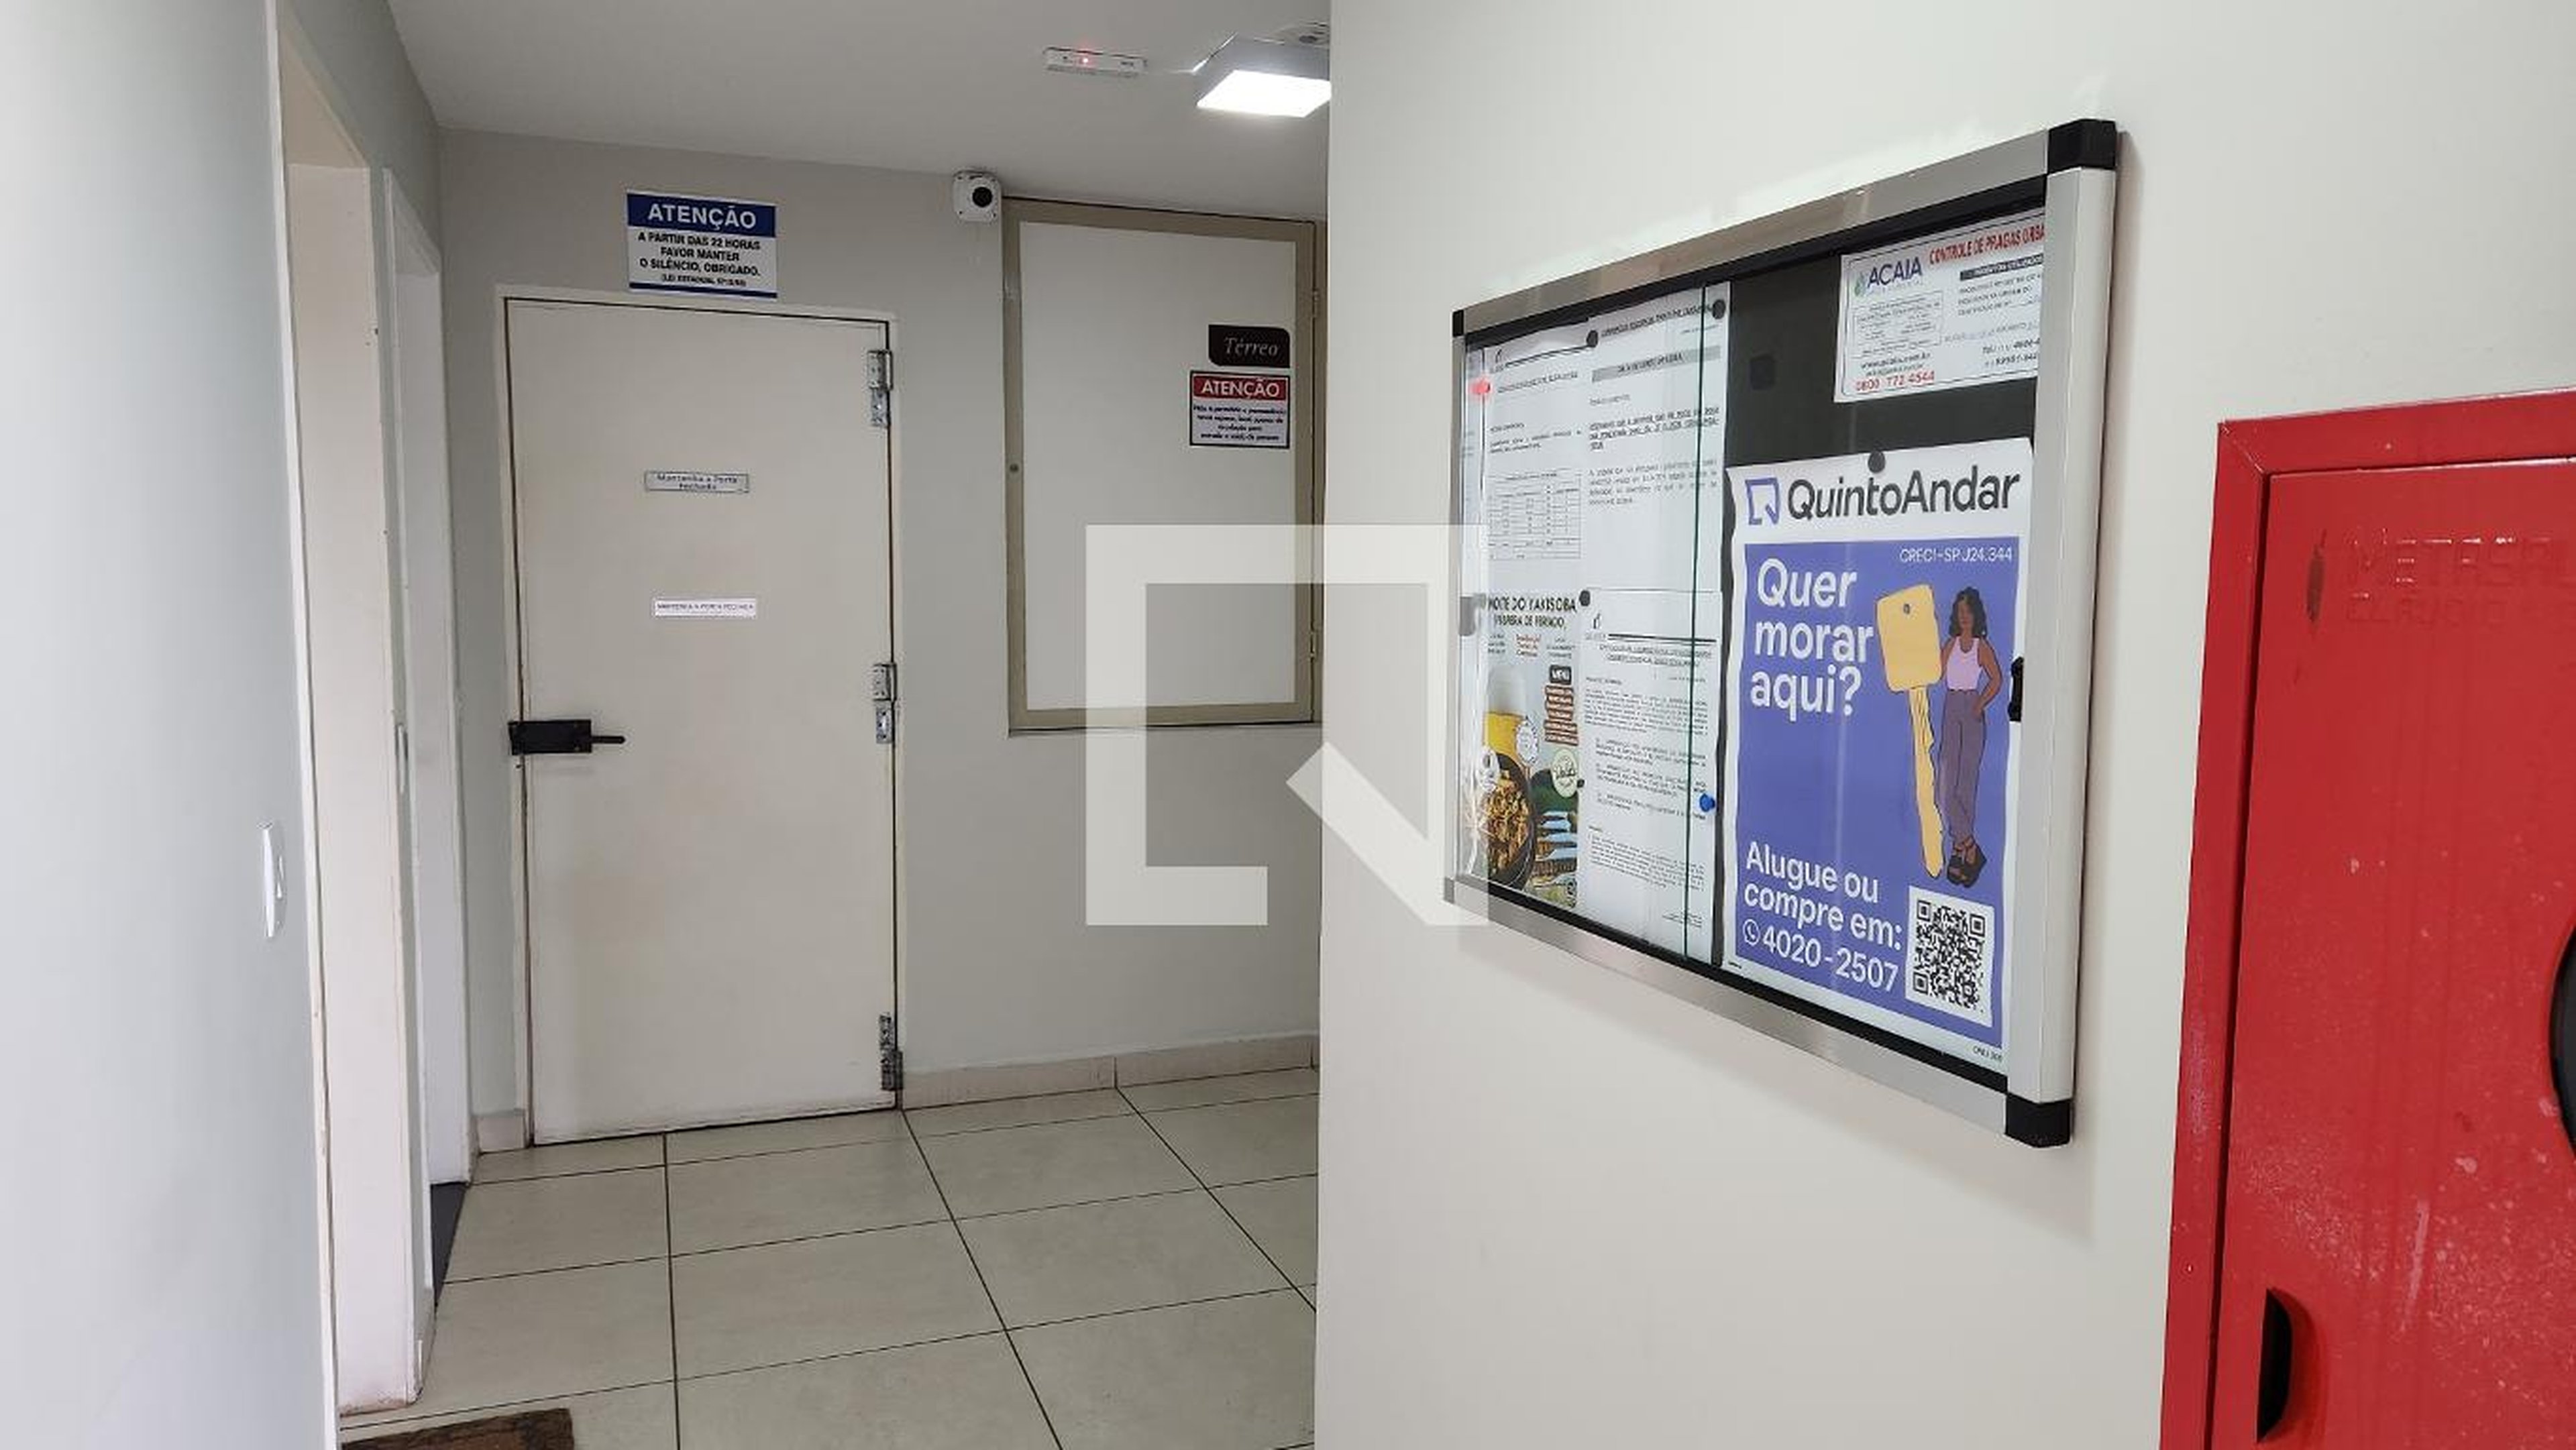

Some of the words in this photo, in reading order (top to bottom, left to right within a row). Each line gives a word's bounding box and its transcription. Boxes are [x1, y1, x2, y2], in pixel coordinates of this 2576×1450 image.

[648, 203, 756, 230] ATENÇÃO
[638, 232, 645, 242] A
[648, 233, 685, 245] PARTIR
[688, 235, 709, 246] DAS
[711, 237, 722, 247] 22
[725, 239, 760, 250] HORAS
[661, 247, 694, 258] FAVOR
[697, 249, 739, 261] MANTER
[1929, 241, 1972, 265] CONTROLE
[1974, 237, 1984, 256] DE
[1986, 229, 2021, 250] PRAGAS
[639, 258, 648, 268] O
[1867, 256, 1923, 288] ACAIA
[1224, 337, 1279, 356] Térreo
[1201, 378, 1279, 400] ATENÇÃO
[1787, 465, 2021, 520] QuintoAndar
[1757, 557, 1858, 608] Quer
[1754, 620, 1875, 664] morar
[1750, 664, 1862, 722] aqui?
[1746, 840, 1838, 891] Alugue
[1844, 872, 1878, 903] ou
[1743, 882, 1844, 932] compre
[1850, 912, 1903, 951] em:
[1762, 928, 1899, 993] 4020-2507
